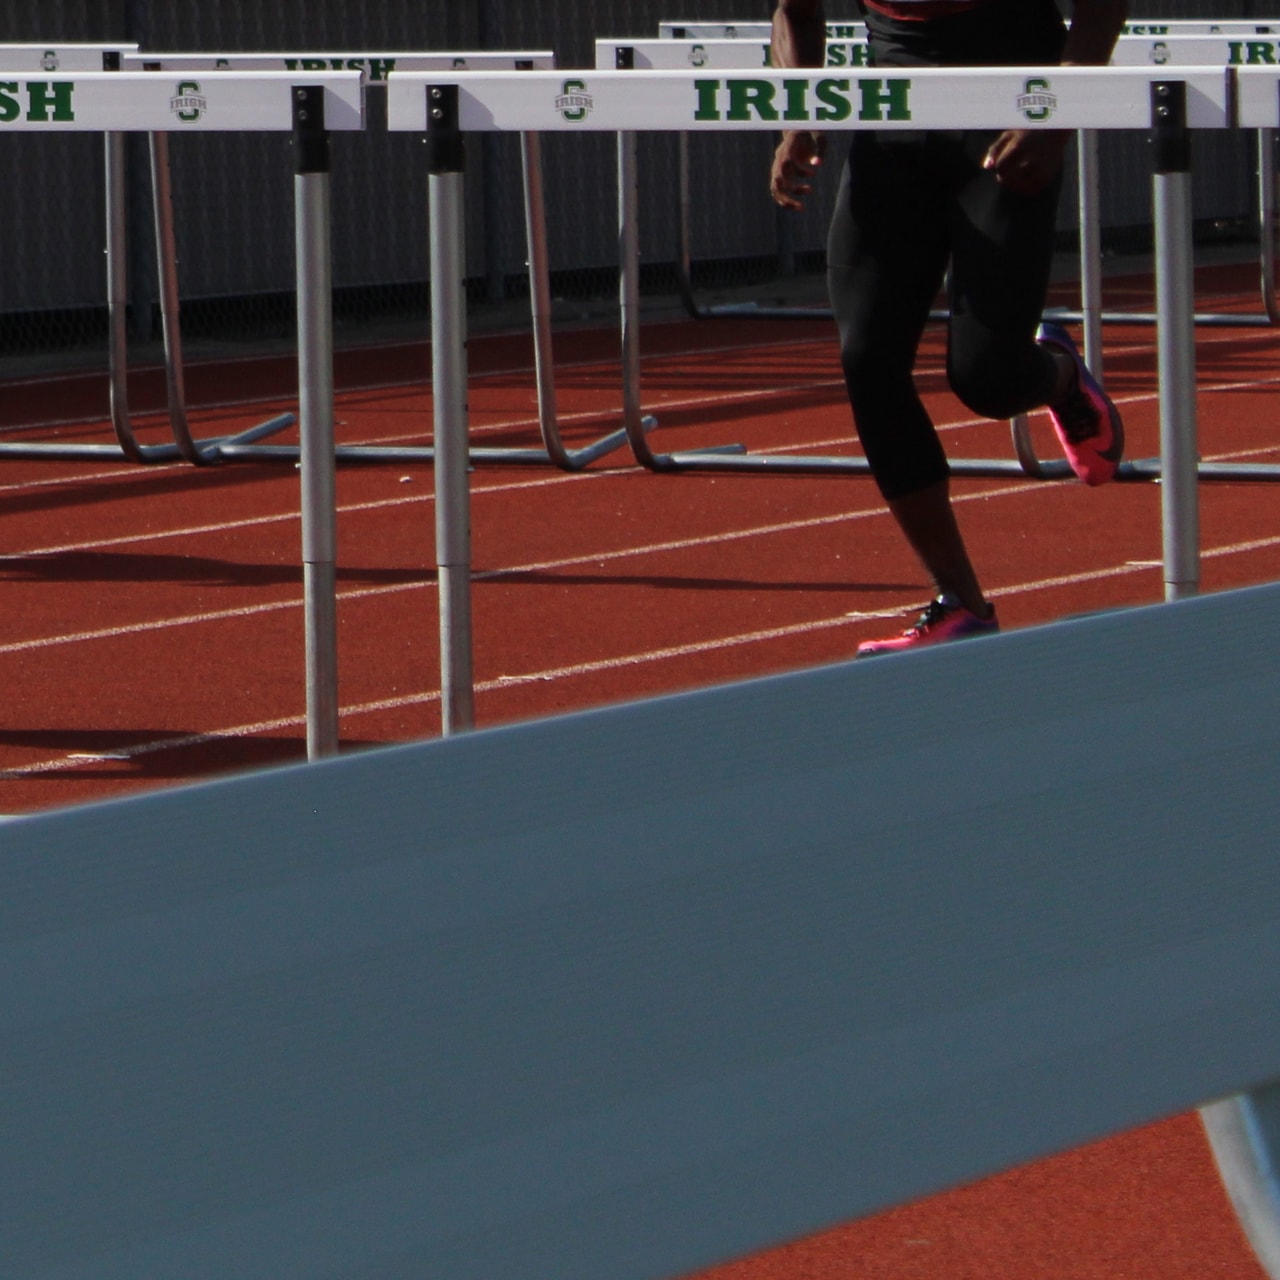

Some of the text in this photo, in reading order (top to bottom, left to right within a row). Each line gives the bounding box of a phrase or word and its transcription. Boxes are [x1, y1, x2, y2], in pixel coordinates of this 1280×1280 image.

[169, 97, 207, 110] IRISH
[555, 96, 593, 109] IRISH
[693, 78, 912, 122] IRISH
[1017, 95, 1057, 109] IRISH
